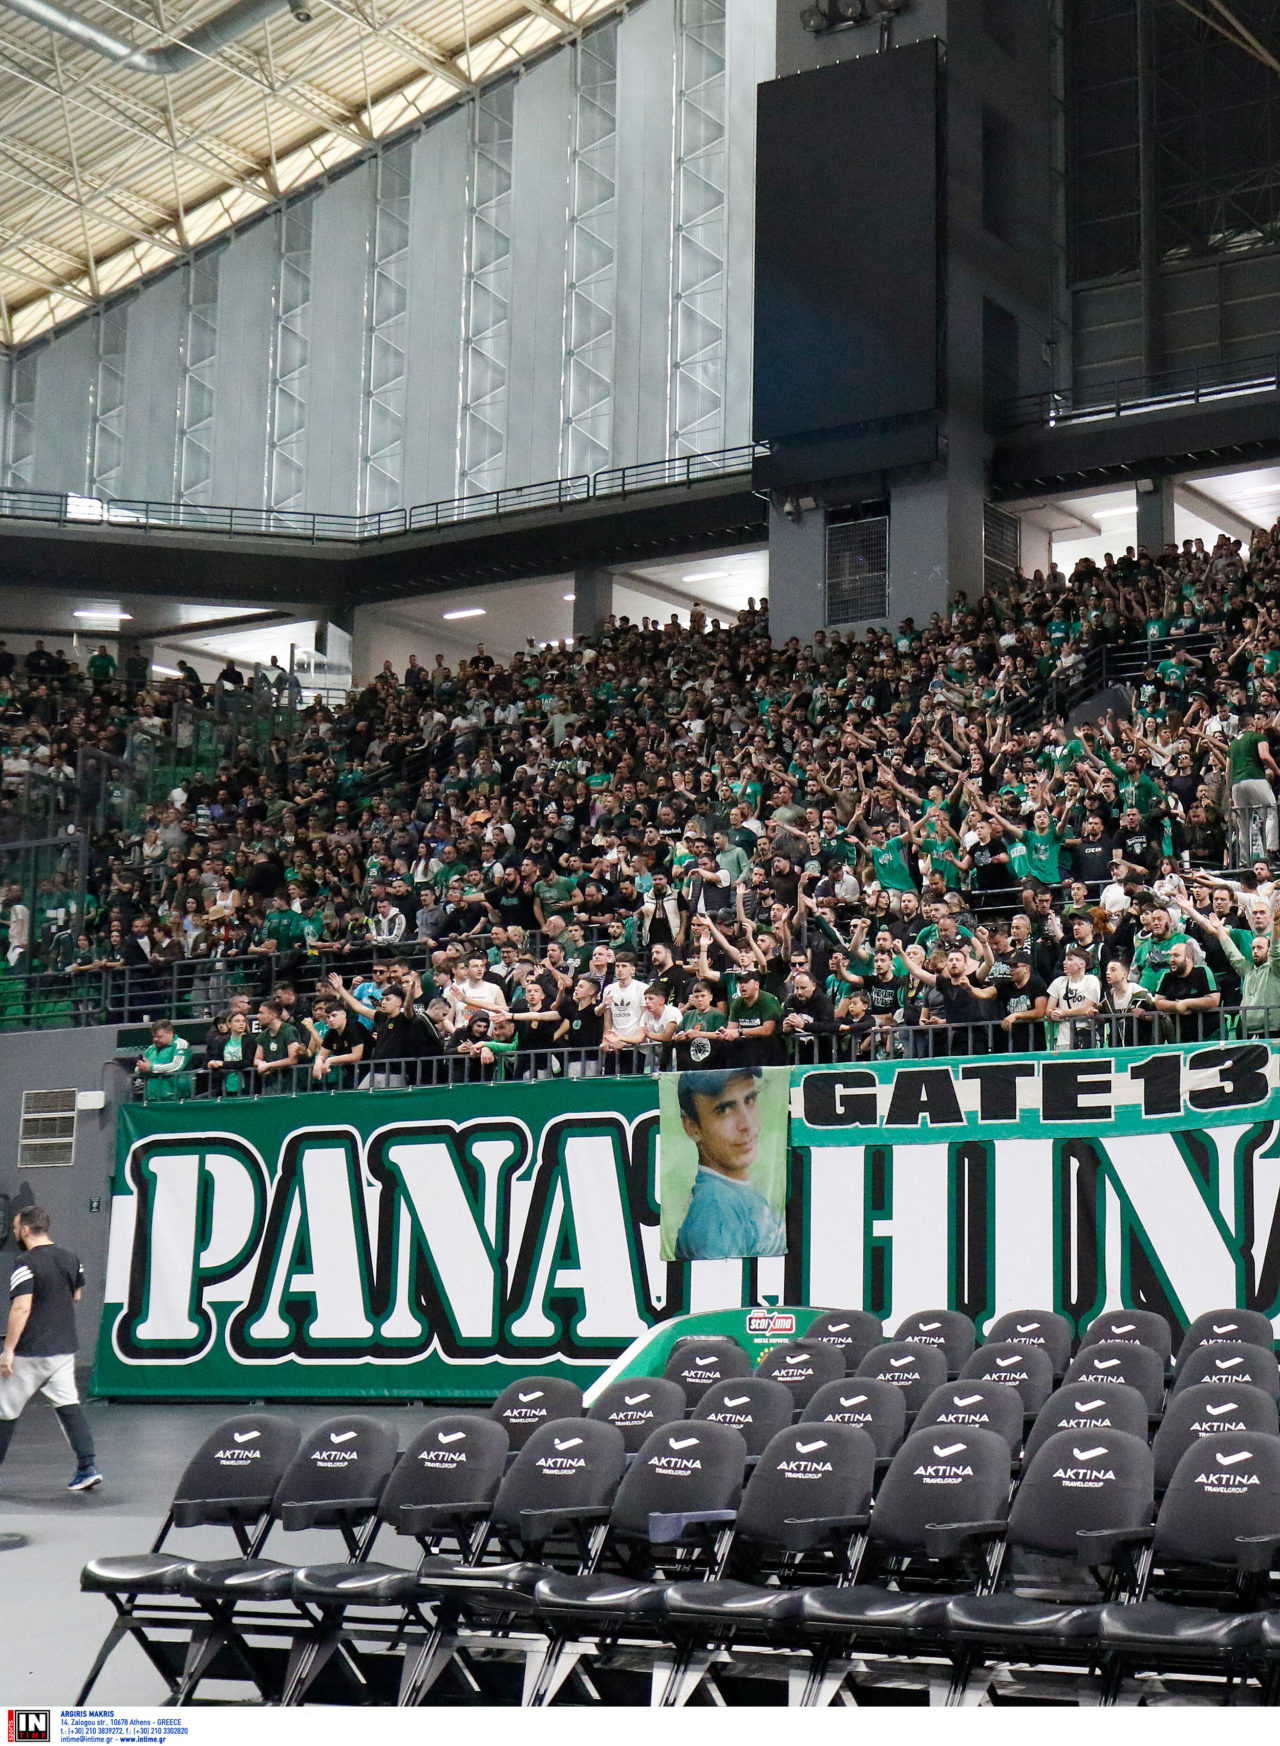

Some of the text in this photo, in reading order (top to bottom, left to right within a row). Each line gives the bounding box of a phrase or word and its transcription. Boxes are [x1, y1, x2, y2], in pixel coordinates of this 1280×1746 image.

[803, 1048, 1270, 1128] GATE 13
[681, 1370, 720, 1378] AKTINA
[1078, 1375, 1125, 1383] AKTINA
[609, 1411, 653, 1419] AKTINA
[706, 1414, 752, 1422] AKTINA
[937, 1414, 989, 1422] AKTINA
[1058, 1419, 1111, 1428] AKTINA
[1190, 1422, 1246, 1431] AKTINA
[215, 1450, 260, 1458] AKTINA
[311, 1451, 357, 1460] AKTINA
[418, 1451, 466, 1461] AKTINA
[536, 1458, 585, 1467] AKTINA
[648, 1457, 701, 1469] AKTINA
[777, 1462, 832, 1471] AKTINA
[914, 1466, 973, 1475] AKTINA
[1053, 1469, 1115, 1479] AKTINA
[1195, 1474, 1260, 1484] AKTINA
